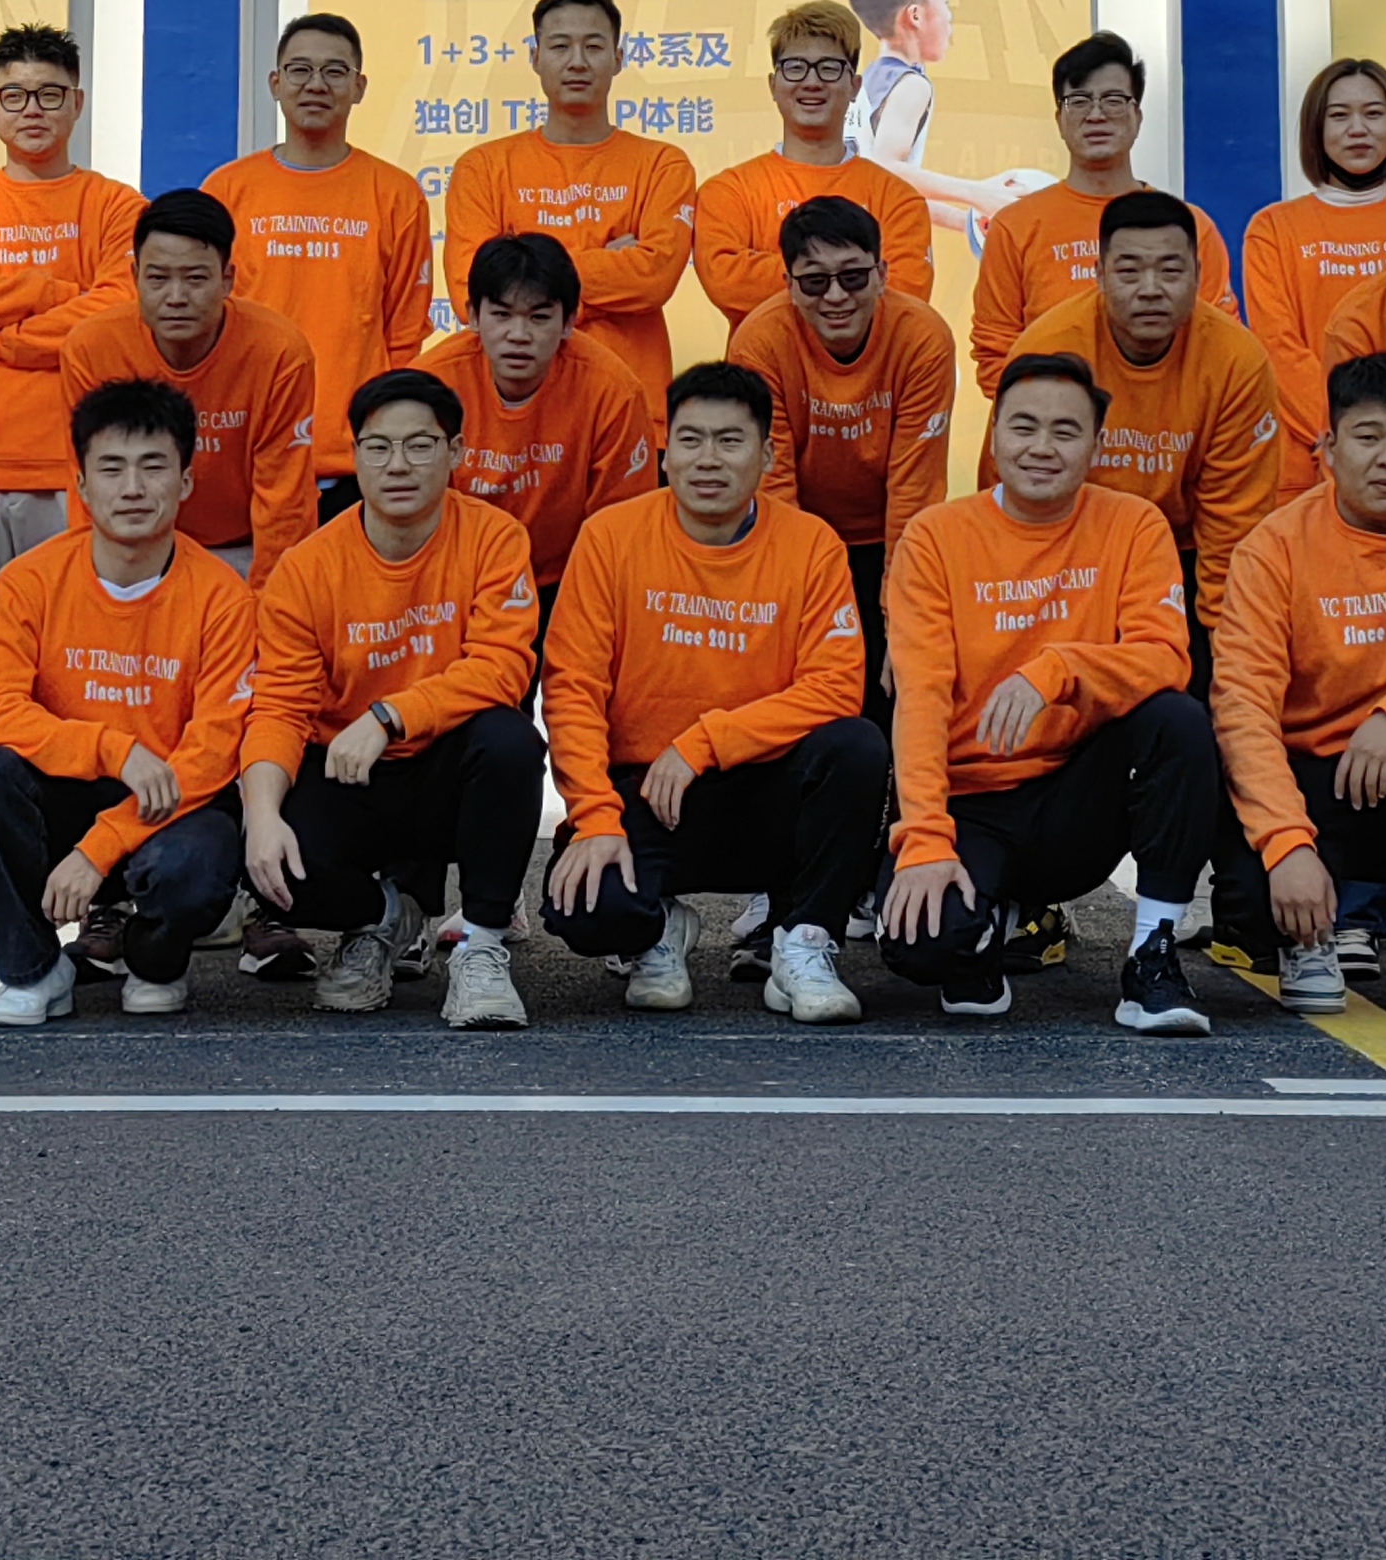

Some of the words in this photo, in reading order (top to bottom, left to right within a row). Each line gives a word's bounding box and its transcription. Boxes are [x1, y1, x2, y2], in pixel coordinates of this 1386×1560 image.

[415, 97, 489, 135] 独创
[518, 188, 535, 204] YC
[593, 185, 628, 203] CAMP
[250, 218, 268, 236] YC
[270, 215, 330, 234] TRAINING
[333, 217, 369, 238] CAMP
[537, 210, 572, 227] Since
[266, 240, 303, 257] Since
[306, 241, 340, 259] 2013
[1052, 243, 1069, 261] YC
[1319, 239, 1380, 258] TRAINING
[1071, 264, 1097, 281] Sinc
[1319, 258, 1356, 277] Since
[810, 394, 865, 420] RAINING
[211, 410, 248, 430] CAMP
[841, 418, 873, 440] 2013
[1099, 427, 1157, 453] RAINING
[530, 442, 564, 463] CAMP
[1137, 454, 1174, 474] 2013
[974, 581, 994, 603] YC
[645, 588, 666, 613] YC
[669, 591, 735, 622] TRAINING
[739, 601, 778, 625] CAMP
[1319, 596, 1340, 618] YC
[994, 610, 1035, 632] Since
[346, 622, 364, 645] YC
[662, 622, 703, 647] Since
[708, 628, 747, 654] 2013
[1343, 625, 1386, 646] Since
[65, 648, 85, 670] YC
[144, 654, 180, 681] CAMP
[368, 645, 406, 671] Since
[84, 680, 124, 704] Since
